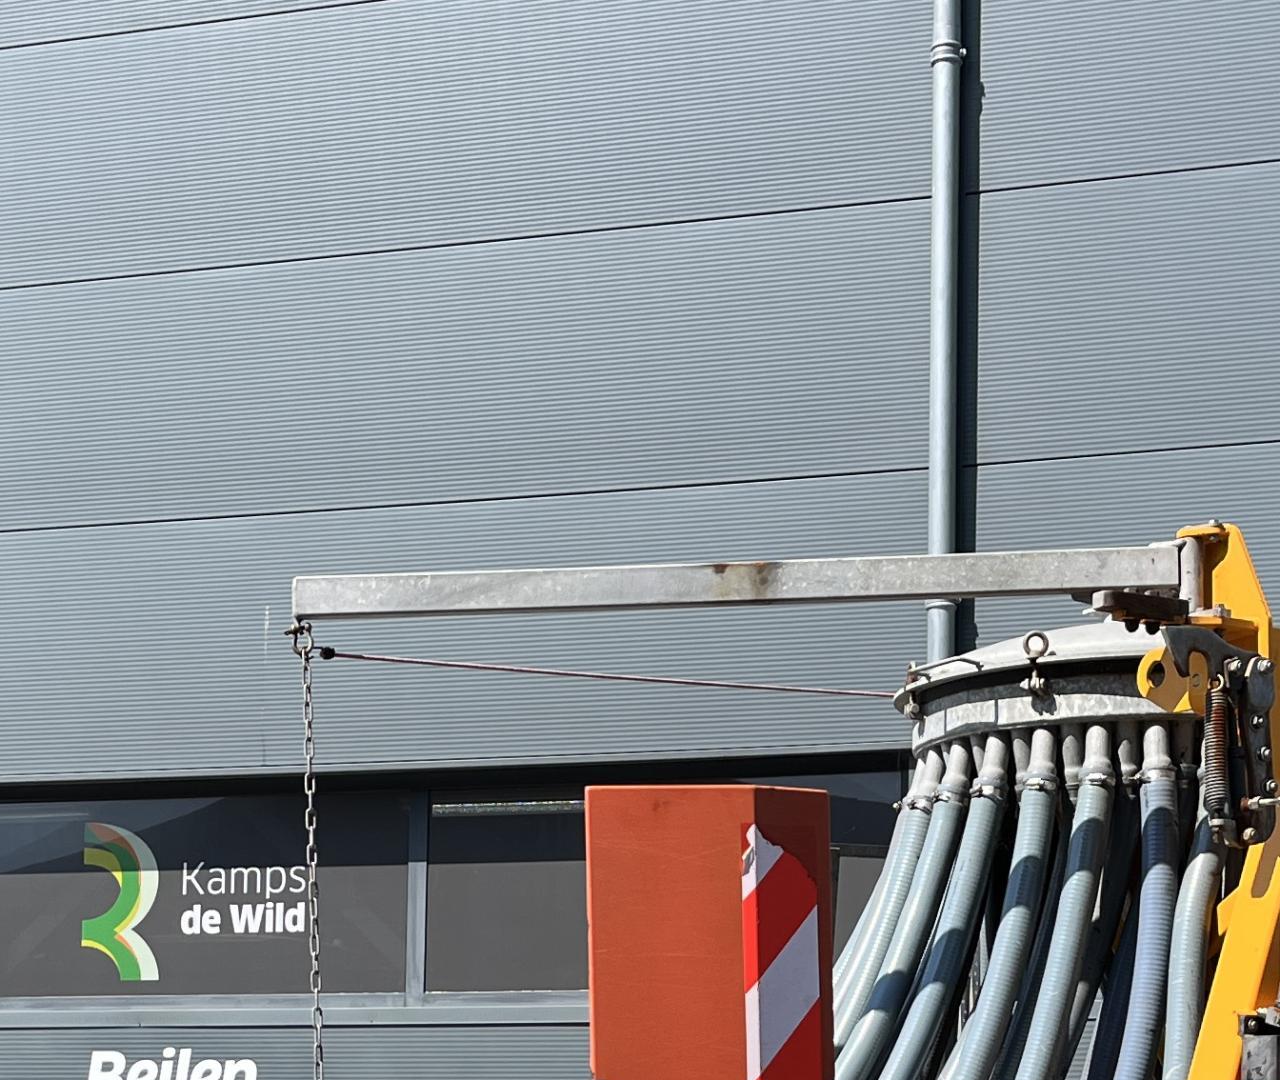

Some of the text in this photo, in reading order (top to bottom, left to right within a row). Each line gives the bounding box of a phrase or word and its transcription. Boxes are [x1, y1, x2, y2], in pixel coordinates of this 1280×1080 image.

[181, 861, 307, 899] Kamps
[180, 901, 306, 935] de Wild
